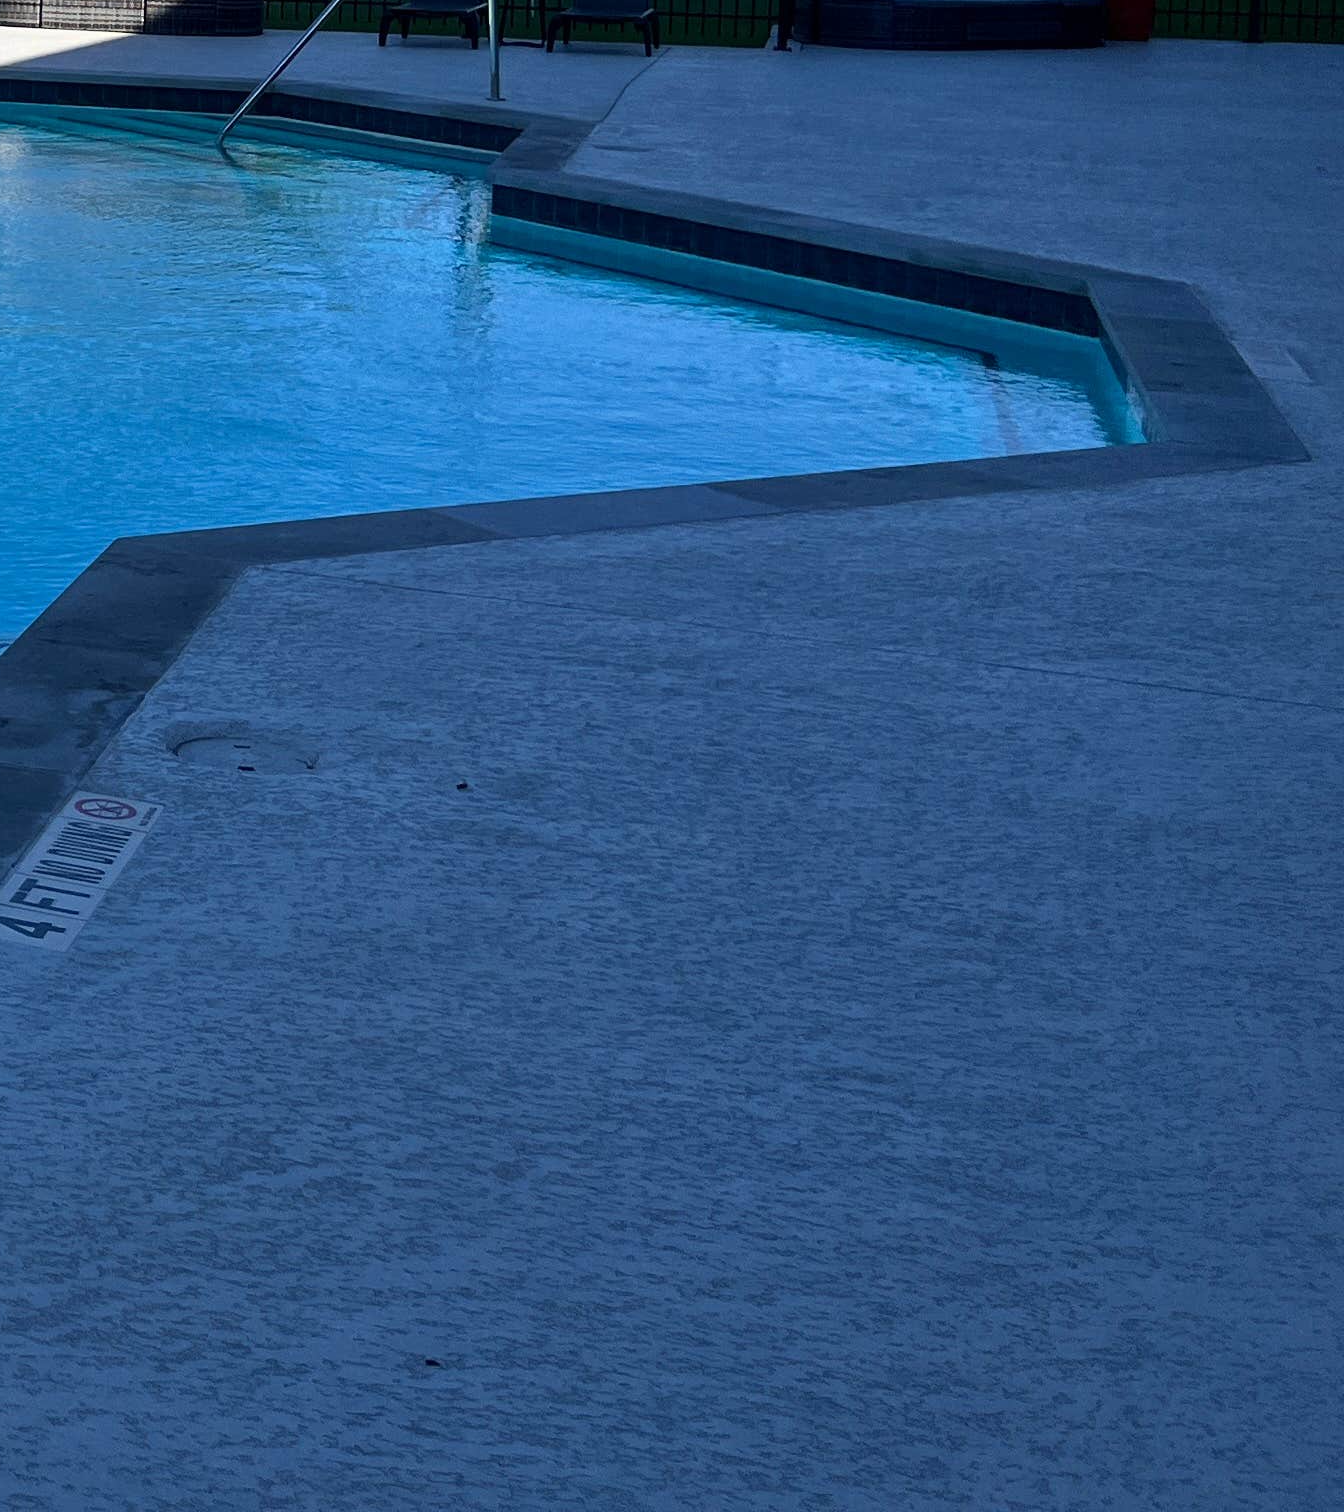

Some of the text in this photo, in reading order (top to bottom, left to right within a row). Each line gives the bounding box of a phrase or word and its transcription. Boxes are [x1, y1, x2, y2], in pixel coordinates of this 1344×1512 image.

[46, 821, 133, 865] DIVING
[31, 859, 106, 884] NO
[9, 878, 91, 916] FT
